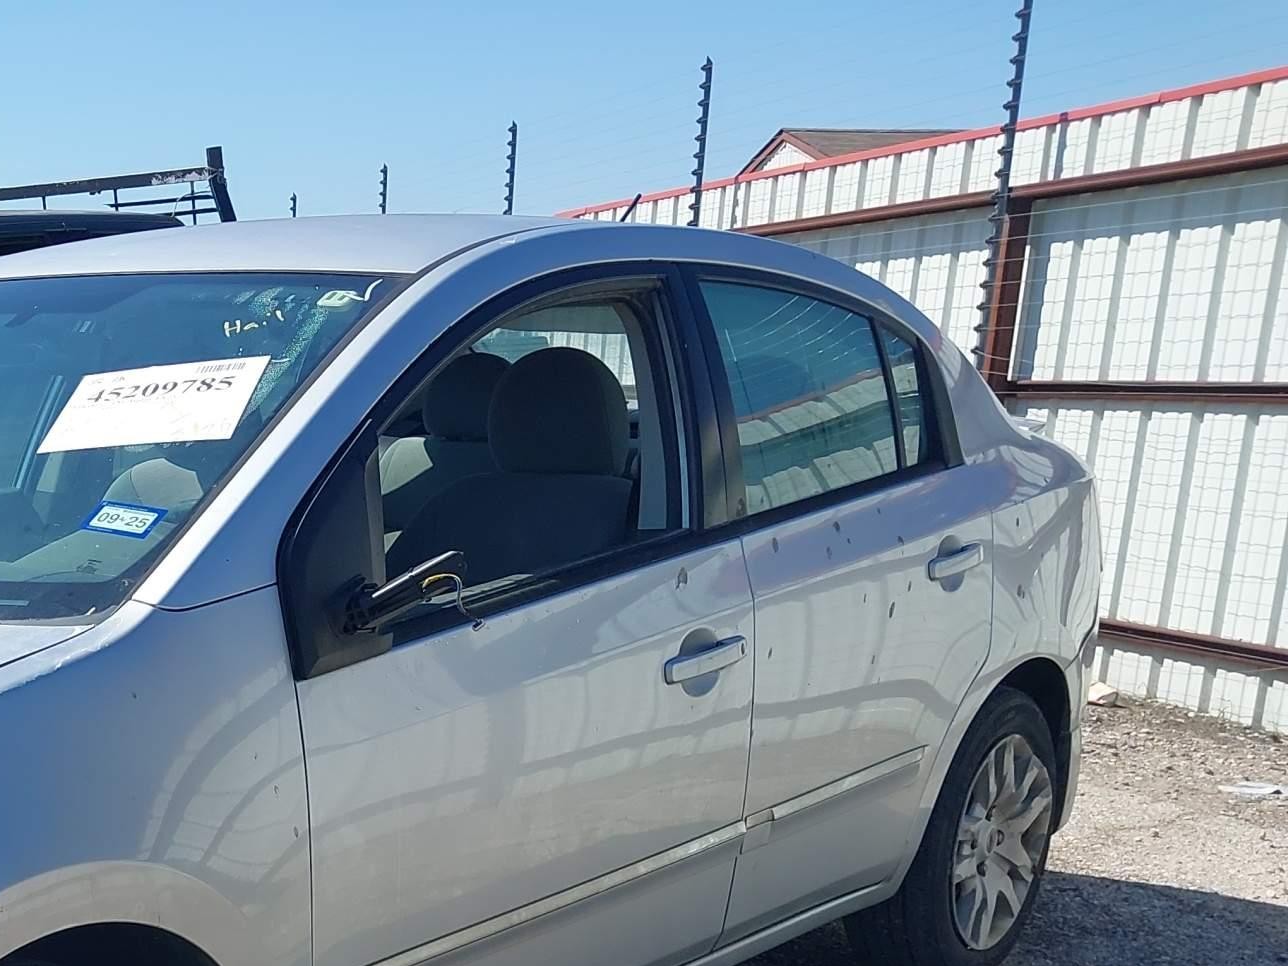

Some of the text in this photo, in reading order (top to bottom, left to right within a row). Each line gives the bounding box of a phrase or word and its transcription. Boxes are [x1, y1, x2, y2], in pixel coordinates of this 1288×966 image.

[86, 375, 237, 403] 45209785
[97, 512, 121, 524] 09
[124, 516, 150, 528] 25
